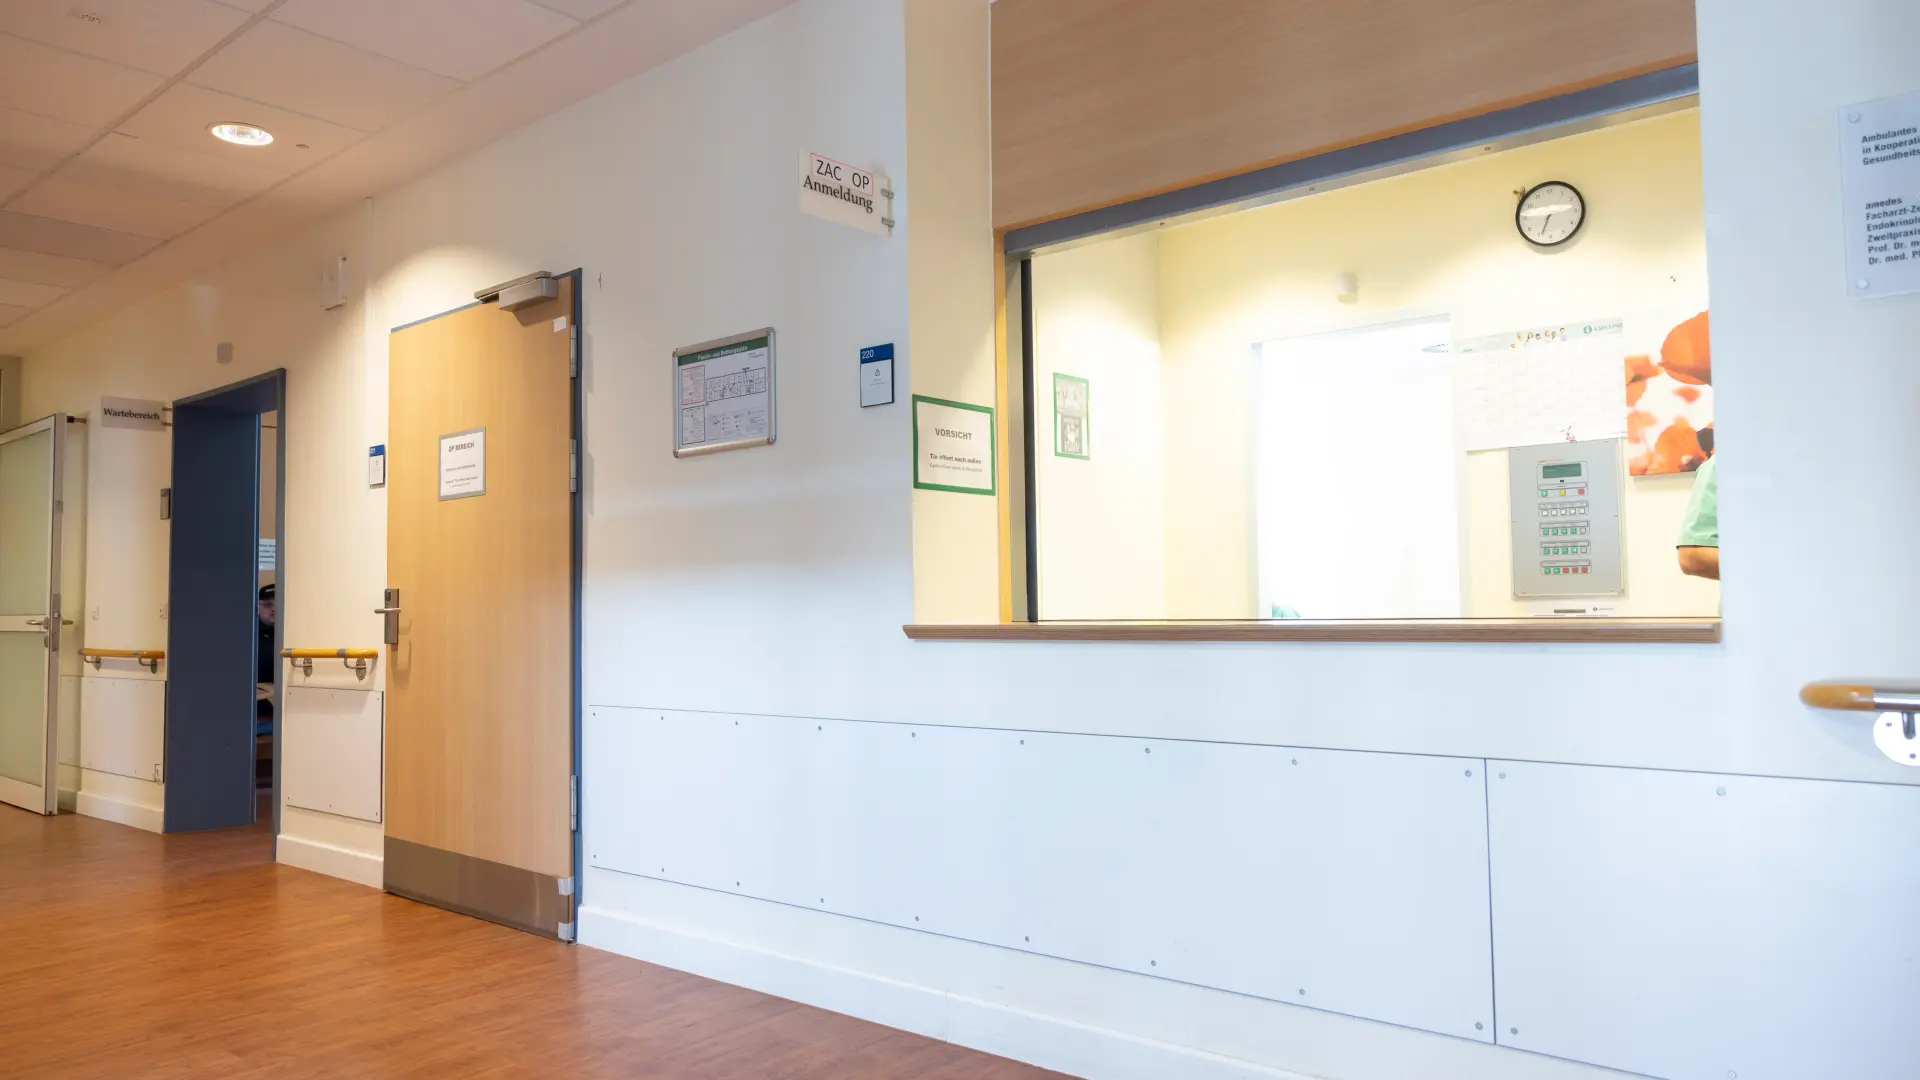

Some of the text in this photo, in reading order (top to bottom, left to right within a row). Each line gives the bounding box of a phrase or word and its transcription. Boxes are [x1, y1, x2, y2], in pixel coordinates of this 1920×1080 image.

[1861, 127, 1917, 143] Ambulantes
[816, 159, 870, 189] ZAC OP
[803, 175, 873, 213] Anmeldung
[1865, 198, 1902, 209] amedes
[1868, 244, 1890, 253] Prof.
[1893, 242, 1907, 250] Dr.
[1868, 257, 1882, 265] Dr.
[1885, 252, 1908, 262] med.
[861, 349, 874, 360] 220
[103, 407, 160, 420] Wartebereich
[934, 427, 972, 440] VORSICHT
[455, 441, 475, 451] BEREICH
